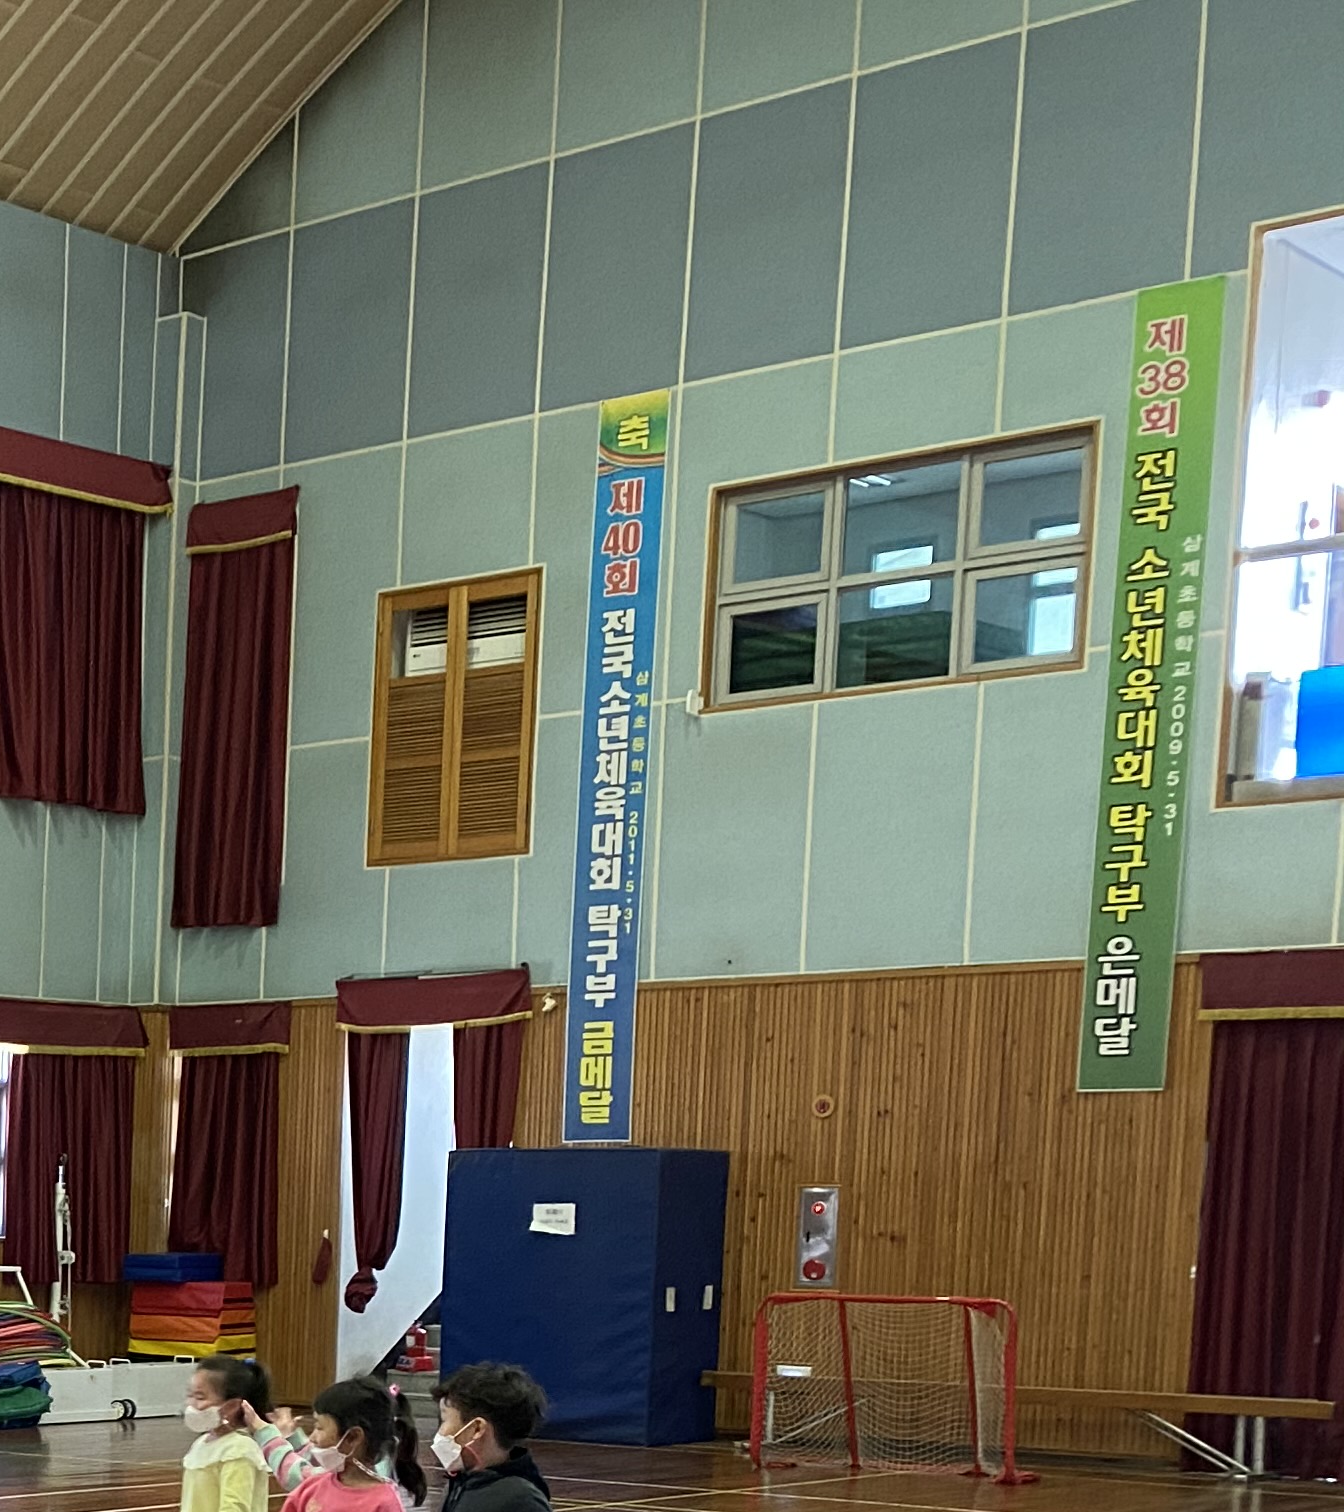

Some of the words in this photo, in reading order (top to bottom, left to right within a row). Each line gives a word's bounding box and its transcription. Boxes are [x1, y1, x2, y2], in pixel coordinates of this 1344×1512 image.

[617, 414, 651, 450] 축
[1136, 314, 1188, 436] 제38회
[601, 477, 645, 598] 제40회
[1100, 802, 1153, 923] 탁구부
[584, 904, 622, 1009] 탁구부
[1093, 935, 1141, 1057] 은메달
[579, 1020, 615, 1125] 금메달
